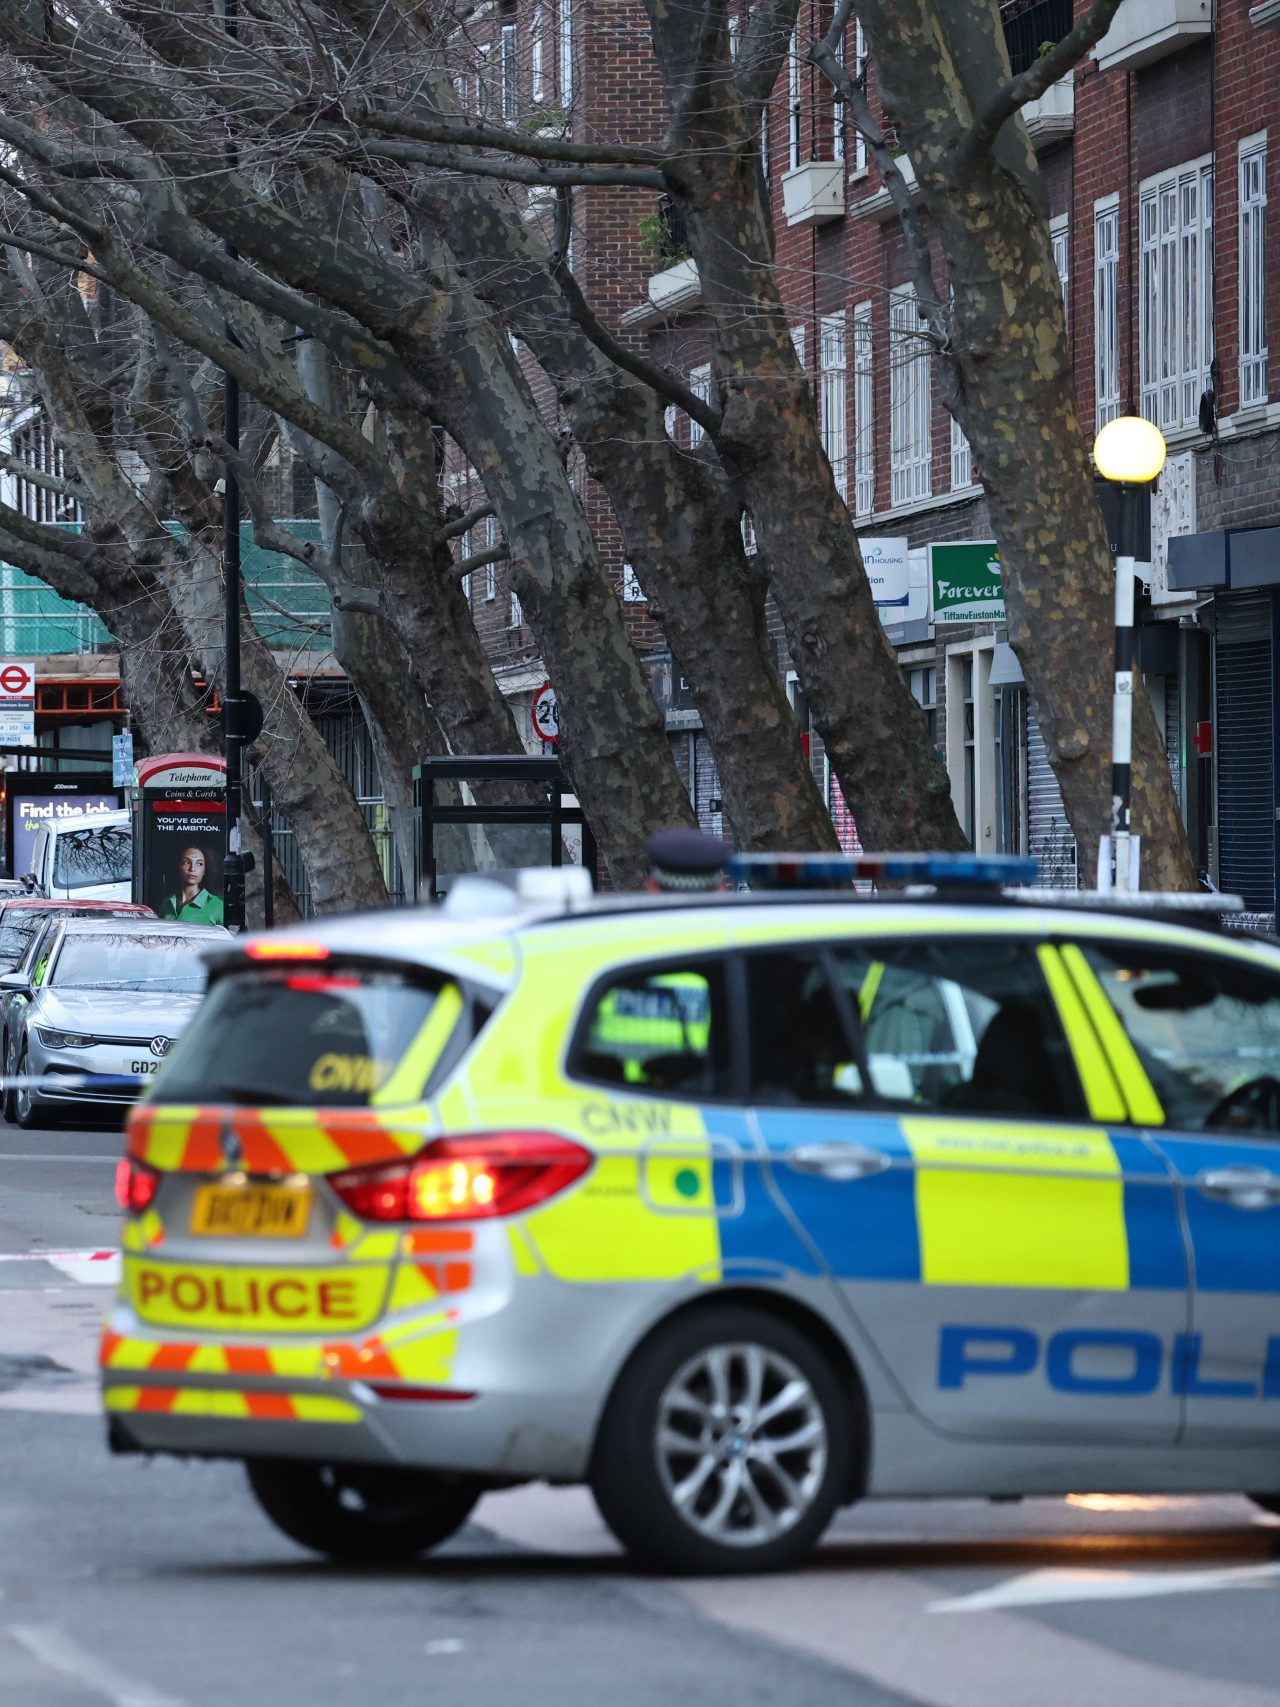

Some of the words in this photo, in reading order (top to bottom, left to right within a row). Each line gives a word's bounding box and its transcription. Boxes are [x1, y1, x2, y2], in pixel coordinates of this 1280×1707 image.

[169, 772, 212, 783] Telephone
[165, 790, 186, 798] Coins
[186, 790, 193, 798] &
[195, 790, 217, 798] Cards
[20, 801, 54, 818] Find
[55, 801, 83, 817] the
[138, 1269, 358, 1320] POLICE
